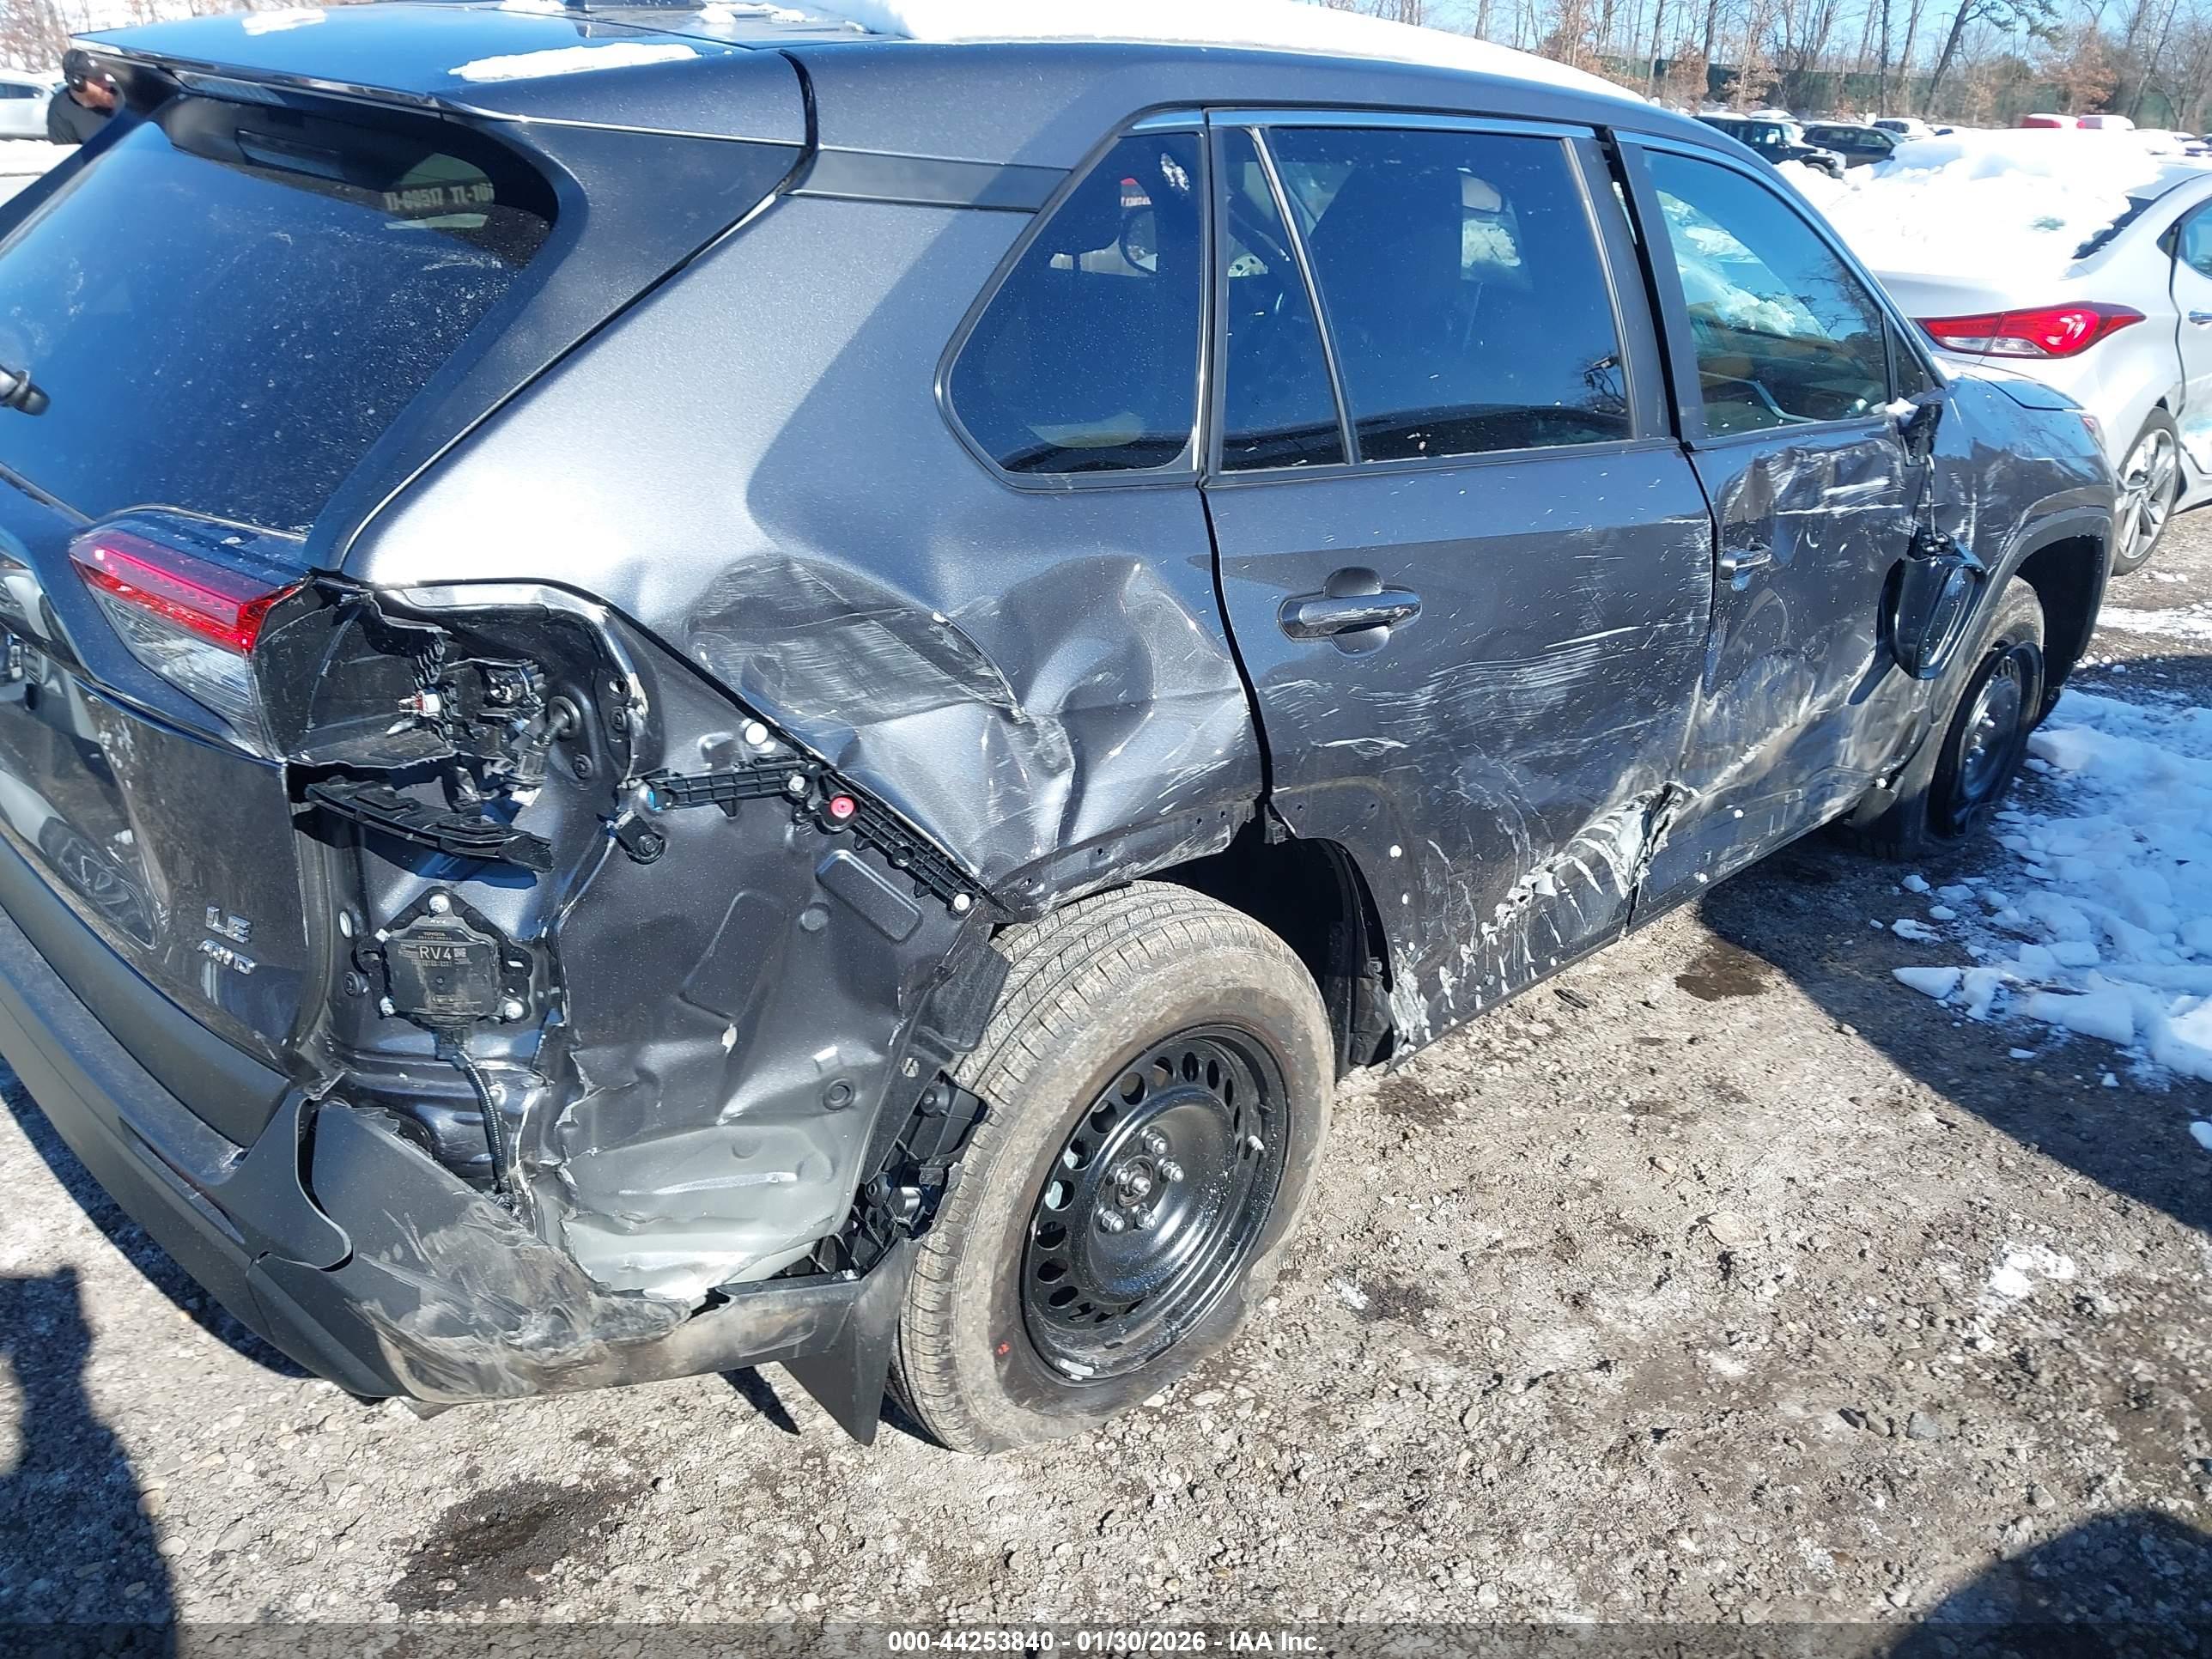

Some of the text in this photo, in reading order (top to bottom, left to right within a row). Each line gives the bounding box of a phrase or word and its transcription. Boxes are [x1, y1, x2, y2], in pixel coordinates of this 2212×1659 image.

[205, 906, 252, 944] LE
[196, 939, 258, 975] AWD
[419, 945, 453, 960] RV4
